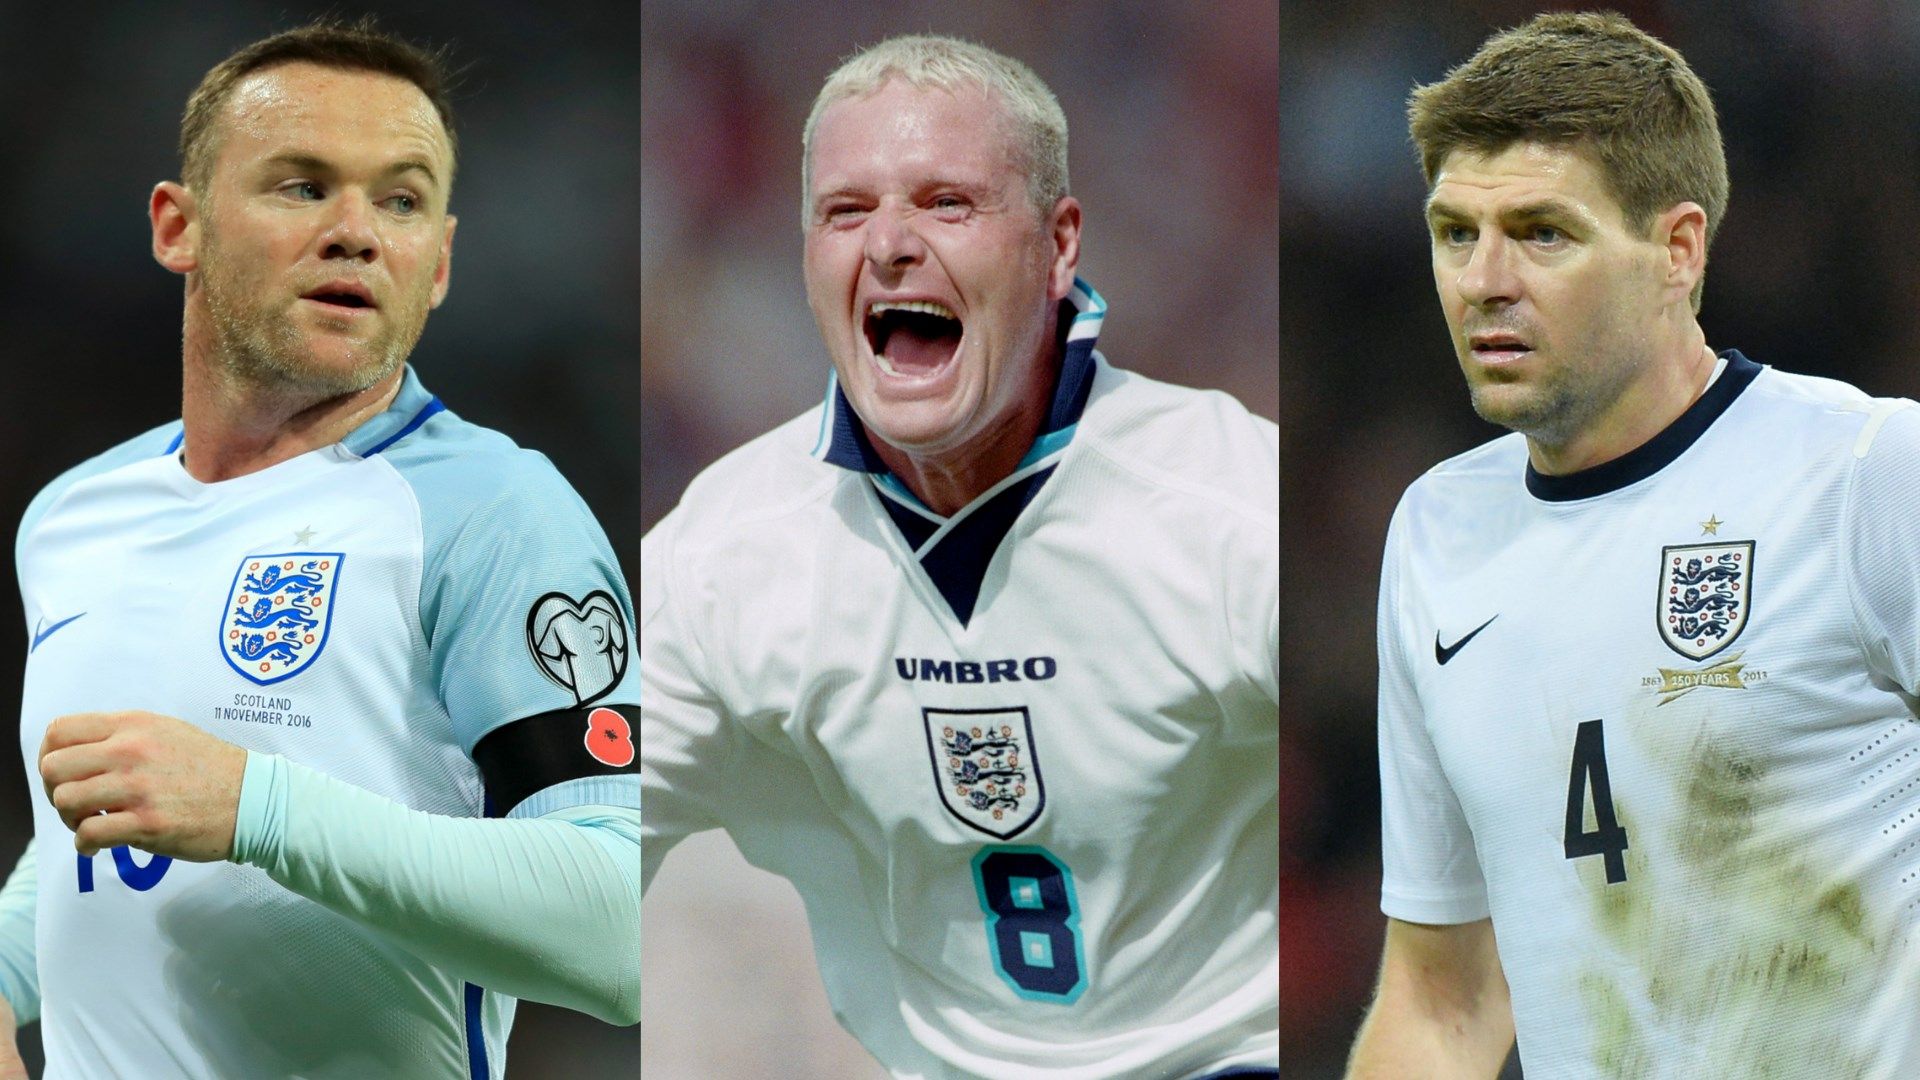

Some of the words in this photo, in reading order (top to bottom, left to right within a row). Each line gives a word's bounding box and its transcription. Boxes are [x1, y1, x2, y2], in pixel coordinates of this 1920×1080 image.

[895, 656, 1057, 684] UMBRO
[1672, 675, 1690, 686] 150
[1692, 673, 1730, 686] YEARS
[1744, 671, 1768, 682] 2013
[234, 693, 292, 711] SCOTLAND
[214, 707, 221, 720] 11
[223, 707, 283, 726] NOVEMBER
[287, 713, 312, 728] 2016
[1564, 719, 1628, 885] 4
[970, 844, 1089, 1007] 8
